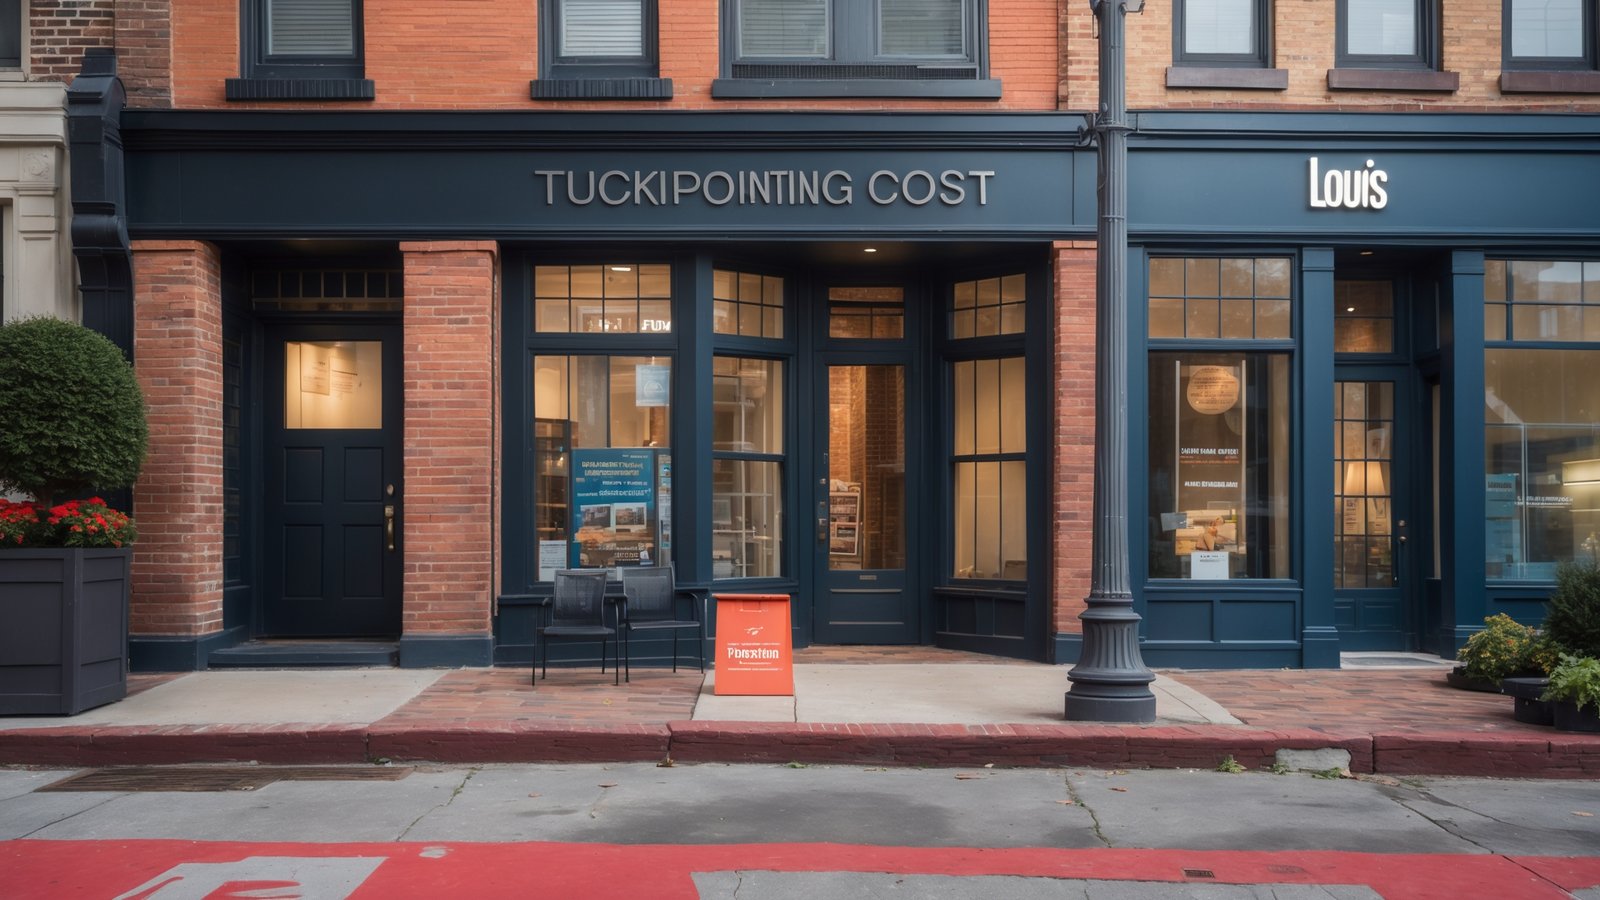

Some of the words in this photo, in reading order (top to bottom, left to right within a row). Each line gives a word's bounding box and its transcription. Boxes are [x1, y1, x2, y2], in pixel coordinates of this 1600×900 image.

[534, 170, 853, 206] TUCKIPOINTING
[868, 169, 996, 206] COST
[1310, 156, 1388, 209] Louis
